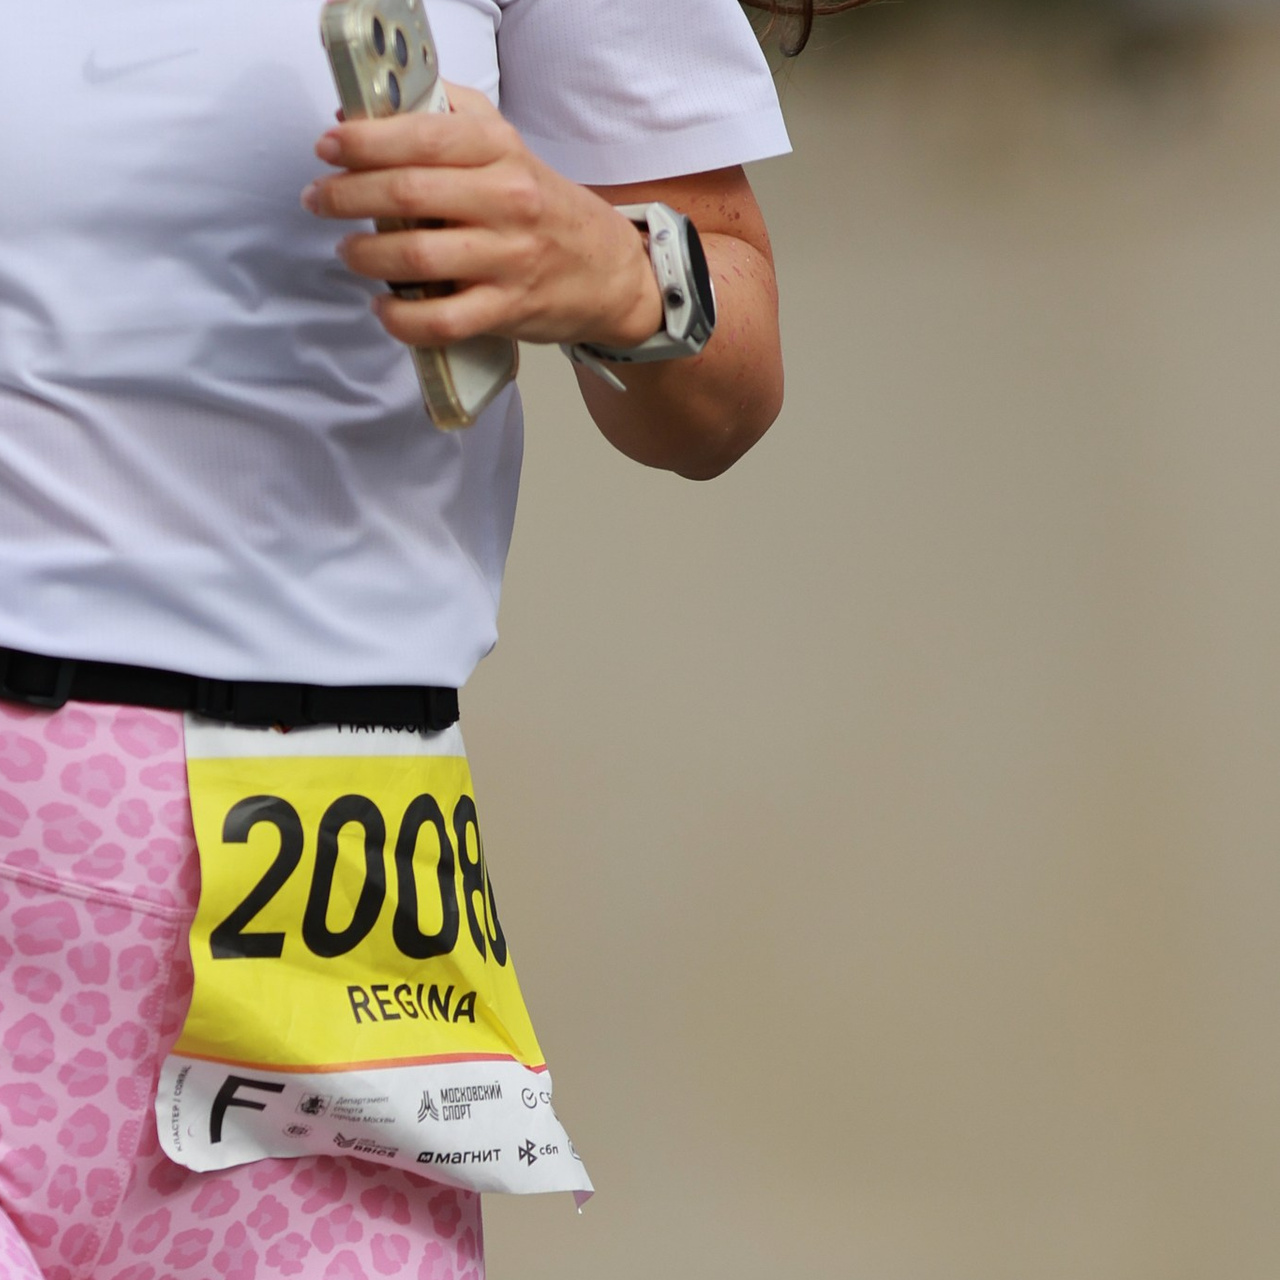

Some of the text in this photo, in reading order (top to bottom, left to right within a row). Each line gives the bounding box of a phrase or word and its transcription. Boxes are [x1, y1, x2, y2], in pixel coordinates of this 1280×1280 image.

[347, 983, 478, 1024] REGINA
[440, 1080, 503, 1104] МОСКОВСКИЙ
[209, 1074, 286, 1145] F
[442, 1103, 471, 1121] СПОРТ
[434, 1148, 501, 1164] магнит
[539, 1143, 559, 1155] сбп
